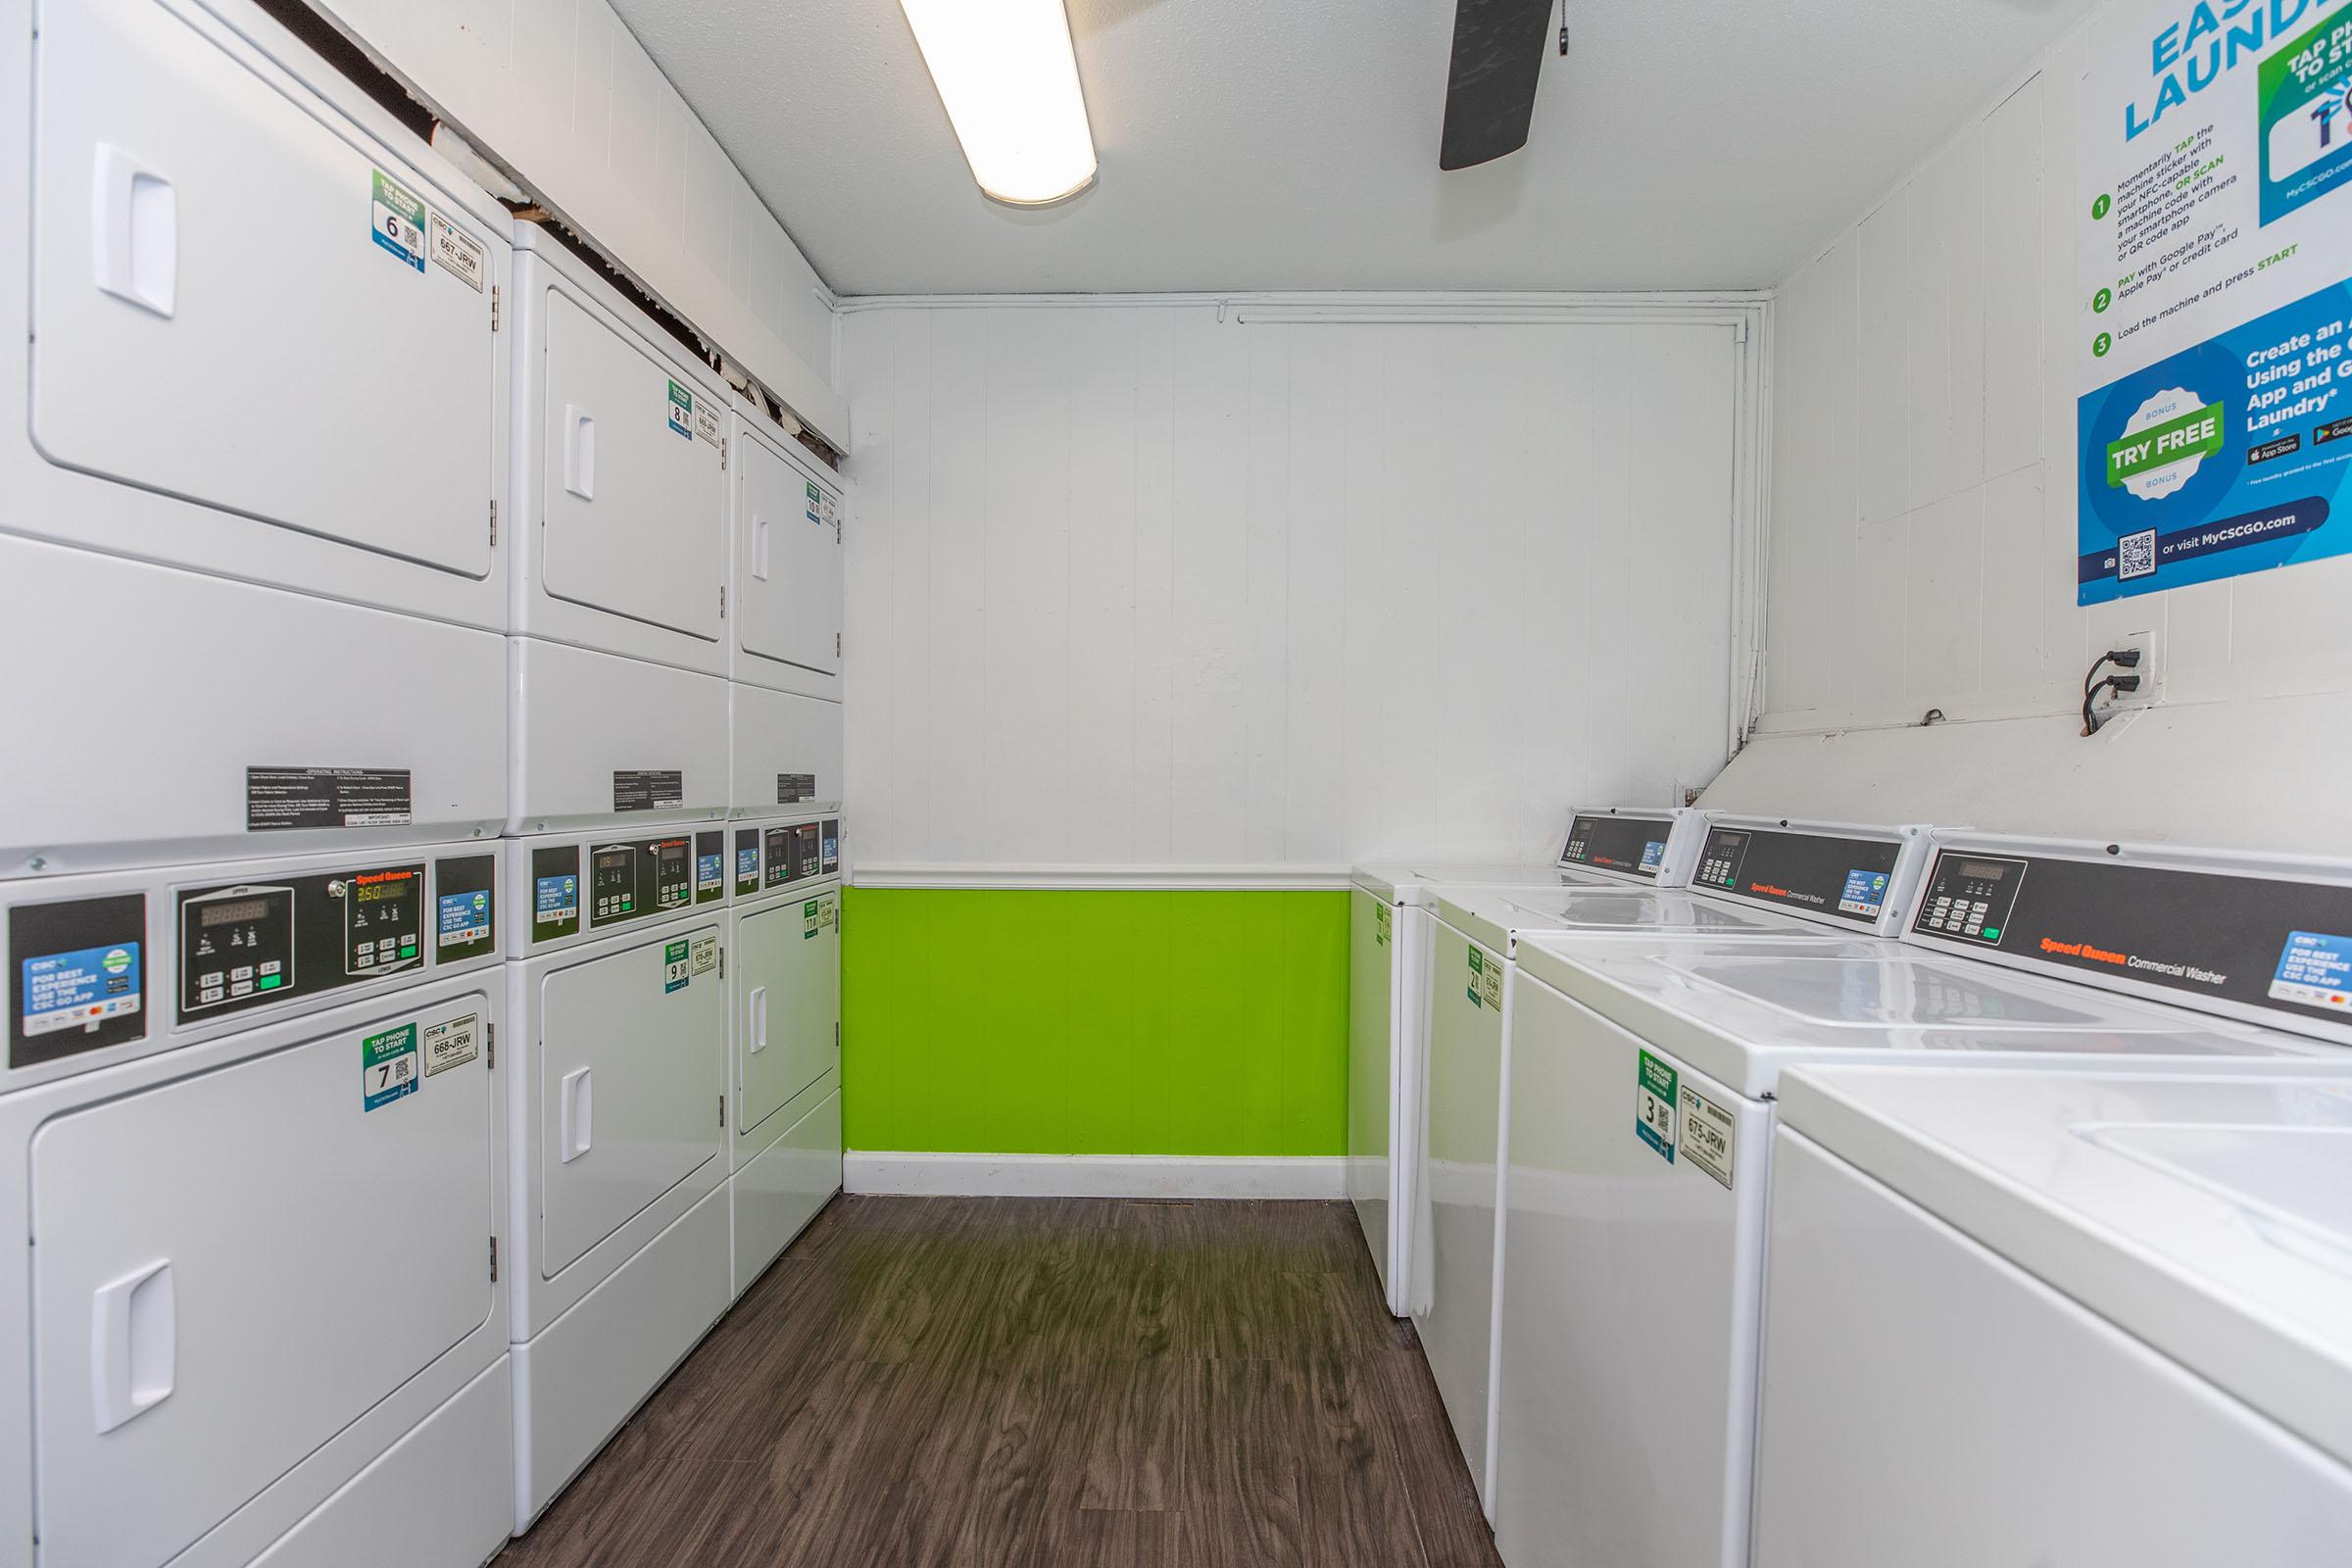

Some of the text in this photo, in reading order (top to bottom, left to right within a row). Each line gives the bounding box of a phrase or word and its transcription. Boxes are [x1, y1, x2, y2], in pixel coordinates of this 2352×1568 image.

[2287, 39, 2326, 73] TAP
[2126, 0, 2328, 142] LAUND
[2296, 57, 2324, 83] TO
[2319, 66, 2342, 85] scan
[2117, 124, 2214, 193] Momentarily TAP the
[2117, 137, 2212, 205] machine sticker with
[2117, 159, 2199, 218] your NFC-capable
[2117, 154, 2224, 227] smartphone, OR SCAN
[2117, 175, 2213, 239] a machine code with
[2117, 174, 2237, 252] your smartphone camera
[387, 216, 398, 237] 6
[2117, 215, 2190, 262] or QR code app
[440, 237, 476, 270] 667-JRW
[2118, 281, 2144, 300] Apple
[2169, 262, 2180, 272] or
[2181, 244, 2213, 266] credit
[2214, 228, 2238, 248] card
[2118, 271, 2135, 288] PAY
[2137, 262, 2157, 277] with
[2159, 242, 2195, 266] Google
[2098, 293, 2106, 310] 2
[2118, 243, 2298, 340] Load the machine and press START
[2098, 338, 2106, 353] 3
[2247, 320, 2342, 368] Create an
[2247, 359, 2301, 389] Using
[2306, 344, 2341, 367] the
[2247, 386, 2287, 411] App
[2292, 367, 2331, 395] and
[674, 407, 680, 421] 8
[2146, 402, 2178, 420] BONUS
[2112, 417, 2215, 469] TRY FREE
[2261, 448, 2277, 459] App
[2278, 442, 2297, 454] Store
[2146, 471, 2178, 488] BONUS
[2163, 514, 2296, 555] or visit MyCSCGO.com
[356, 871, 412, 885] Speed Queen
[1750, 883, 1826, 905] Speed Queen Commercial Washer
[671, 964, 677, 980] 9
[2040, 938, 2228, 985] Speed Queen Commercial Washer
[371, 1029, 410, 1048] TAP PHONE
[374, 1046, 384, 1054] TO
[385, 1038, 407, 1052] START
[426, 1028, 440, 1038] CSC
[434, 1033, 470, 1054] 668-JRW
[1644, 1056, 1653, 1068] TAP
[1645, 1067, 1653, 1079] TO
[378, 1064, 390, 1089] 7
[1646, 1096, 1654, 1123] 3
[1683, 1091, 1695, 1105] CSC
[1689, 1117, 1726, 1153] 675-JRW
